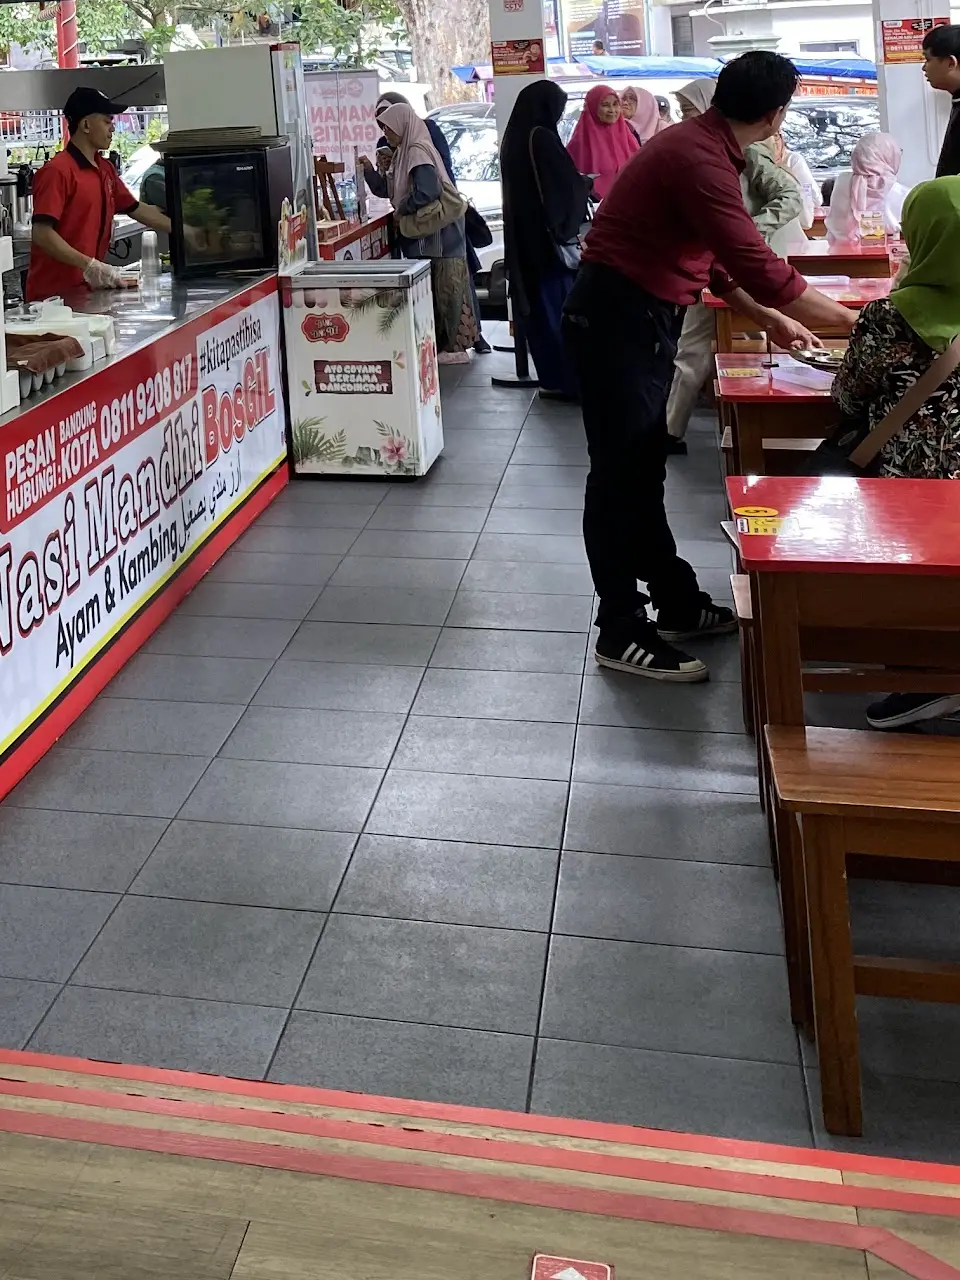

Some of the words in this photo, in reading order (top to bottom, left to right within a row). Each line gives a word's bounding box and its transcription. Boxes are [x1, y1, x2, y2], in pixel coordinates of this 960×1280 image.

[200, 316, 262, 378] #kitapastibisa
[6, 426, 56, 491] PESAN
[60, 401, 96, 444] BANDUNG
[7, 462, 56, 521] HUBUNGI
[61, 428, 99, 483] KOTA
[100, 390, 134, 450] 0811
[136, 368, 172, 425] 9208
[173, 354, 192, 400] 817
[84, 400, 202, 577] Mandhi
[56, 590, 100, 670] Ayam
[104, 566, 116, 614] &
[118, 518, 178, 600] Kambing
